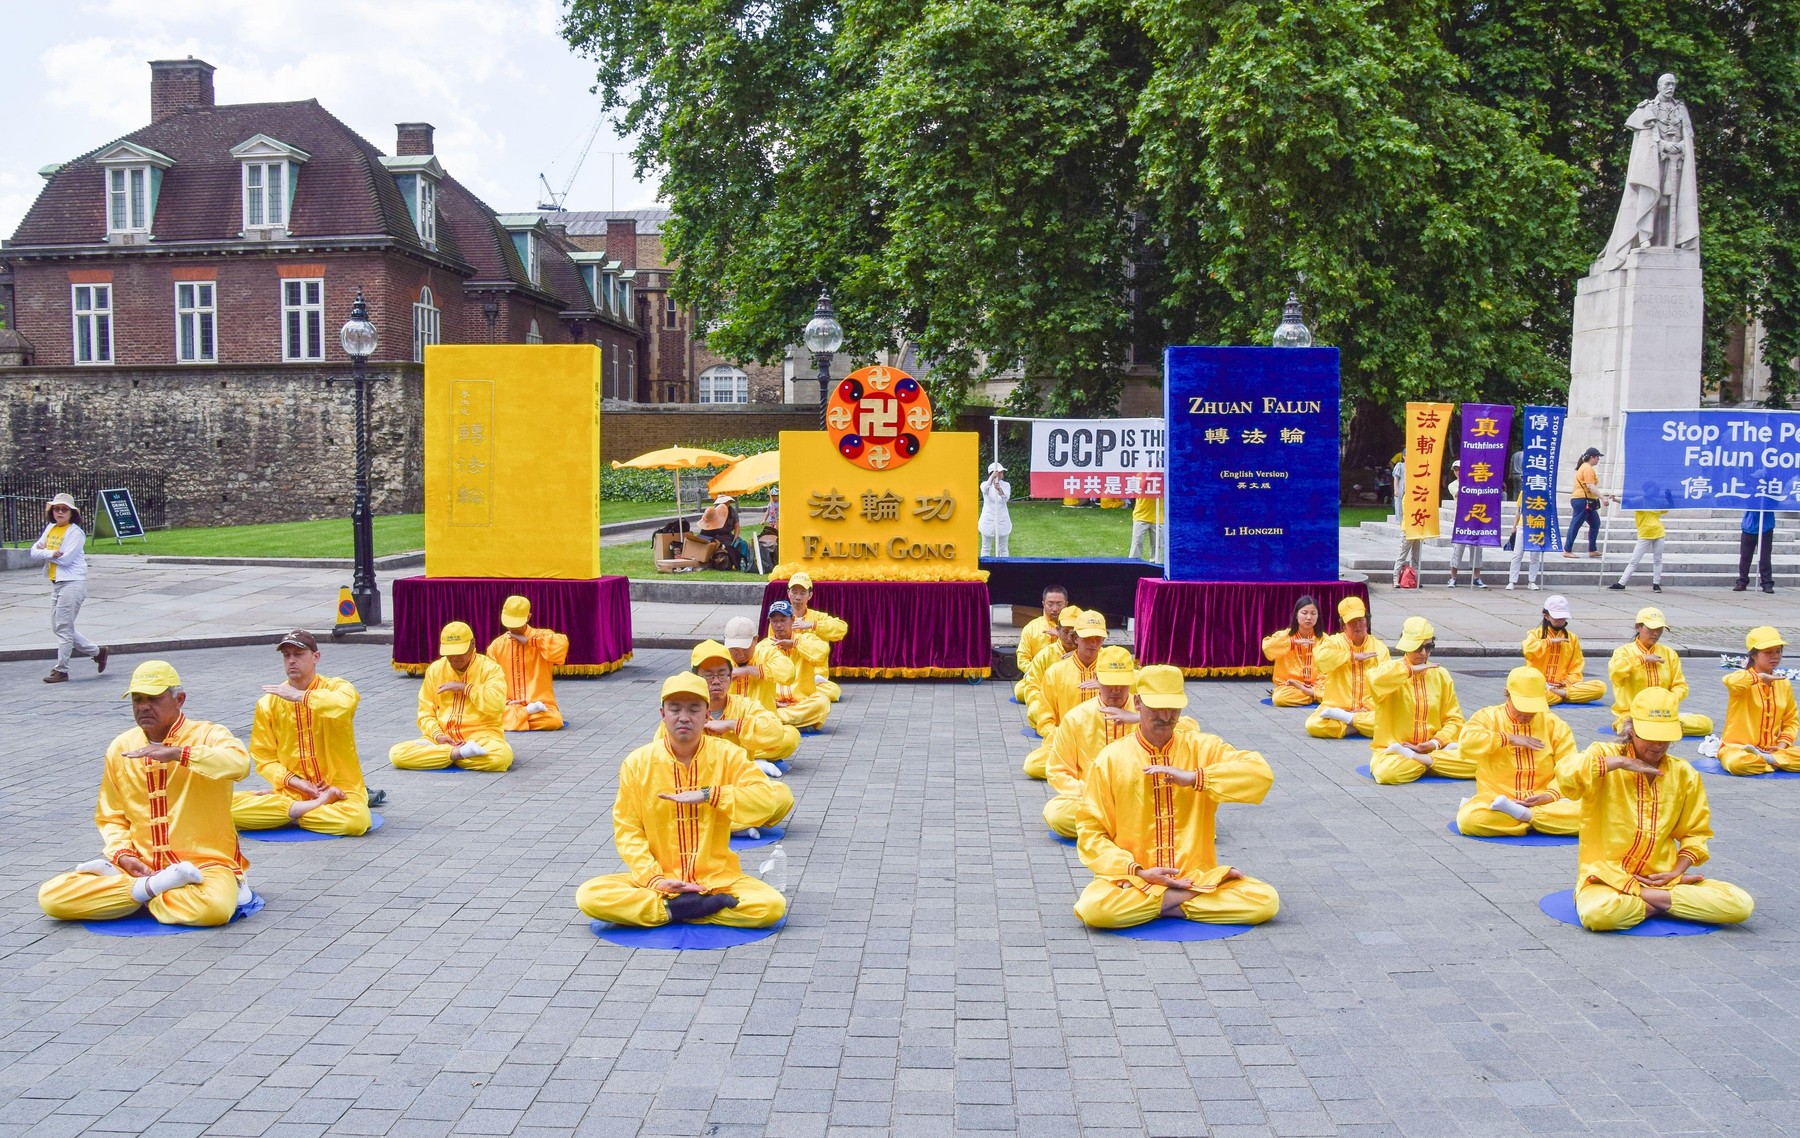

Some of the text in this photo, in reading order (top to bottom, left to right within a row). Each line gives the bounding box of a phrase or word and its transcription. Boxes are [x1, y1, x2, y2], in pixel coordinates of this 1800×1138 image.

[1188, 397, 1321, 415] ZHUAN FALUN
[1204, 427, 1306, 444] 轉法輪
[1470, 417, 1500, 438] 真
[1552, 416, 1560, 436] STOP
[1661, 420, 1720, 445] Stop
[1727, 421, 1773, 443] The
[1047, 428, 1117, 468] CCP
[1120, 428, 1136, 448] IS
[1684, 446, 1754, 468] Falun
[1120, 450, 1139, 468] OF
[1220, 470, 1289, 480] (English Version)
[1467, 461, 1494, 483] 善
[1063, 476, 1162, 495] 中共是真正
[807, 488, 956, 522] 法輪功
[1464, 503, 1492, 524] 忍
[802, 535, 956, 560] FALUN GONG
[1550, 527, 1559, 550] GONG
